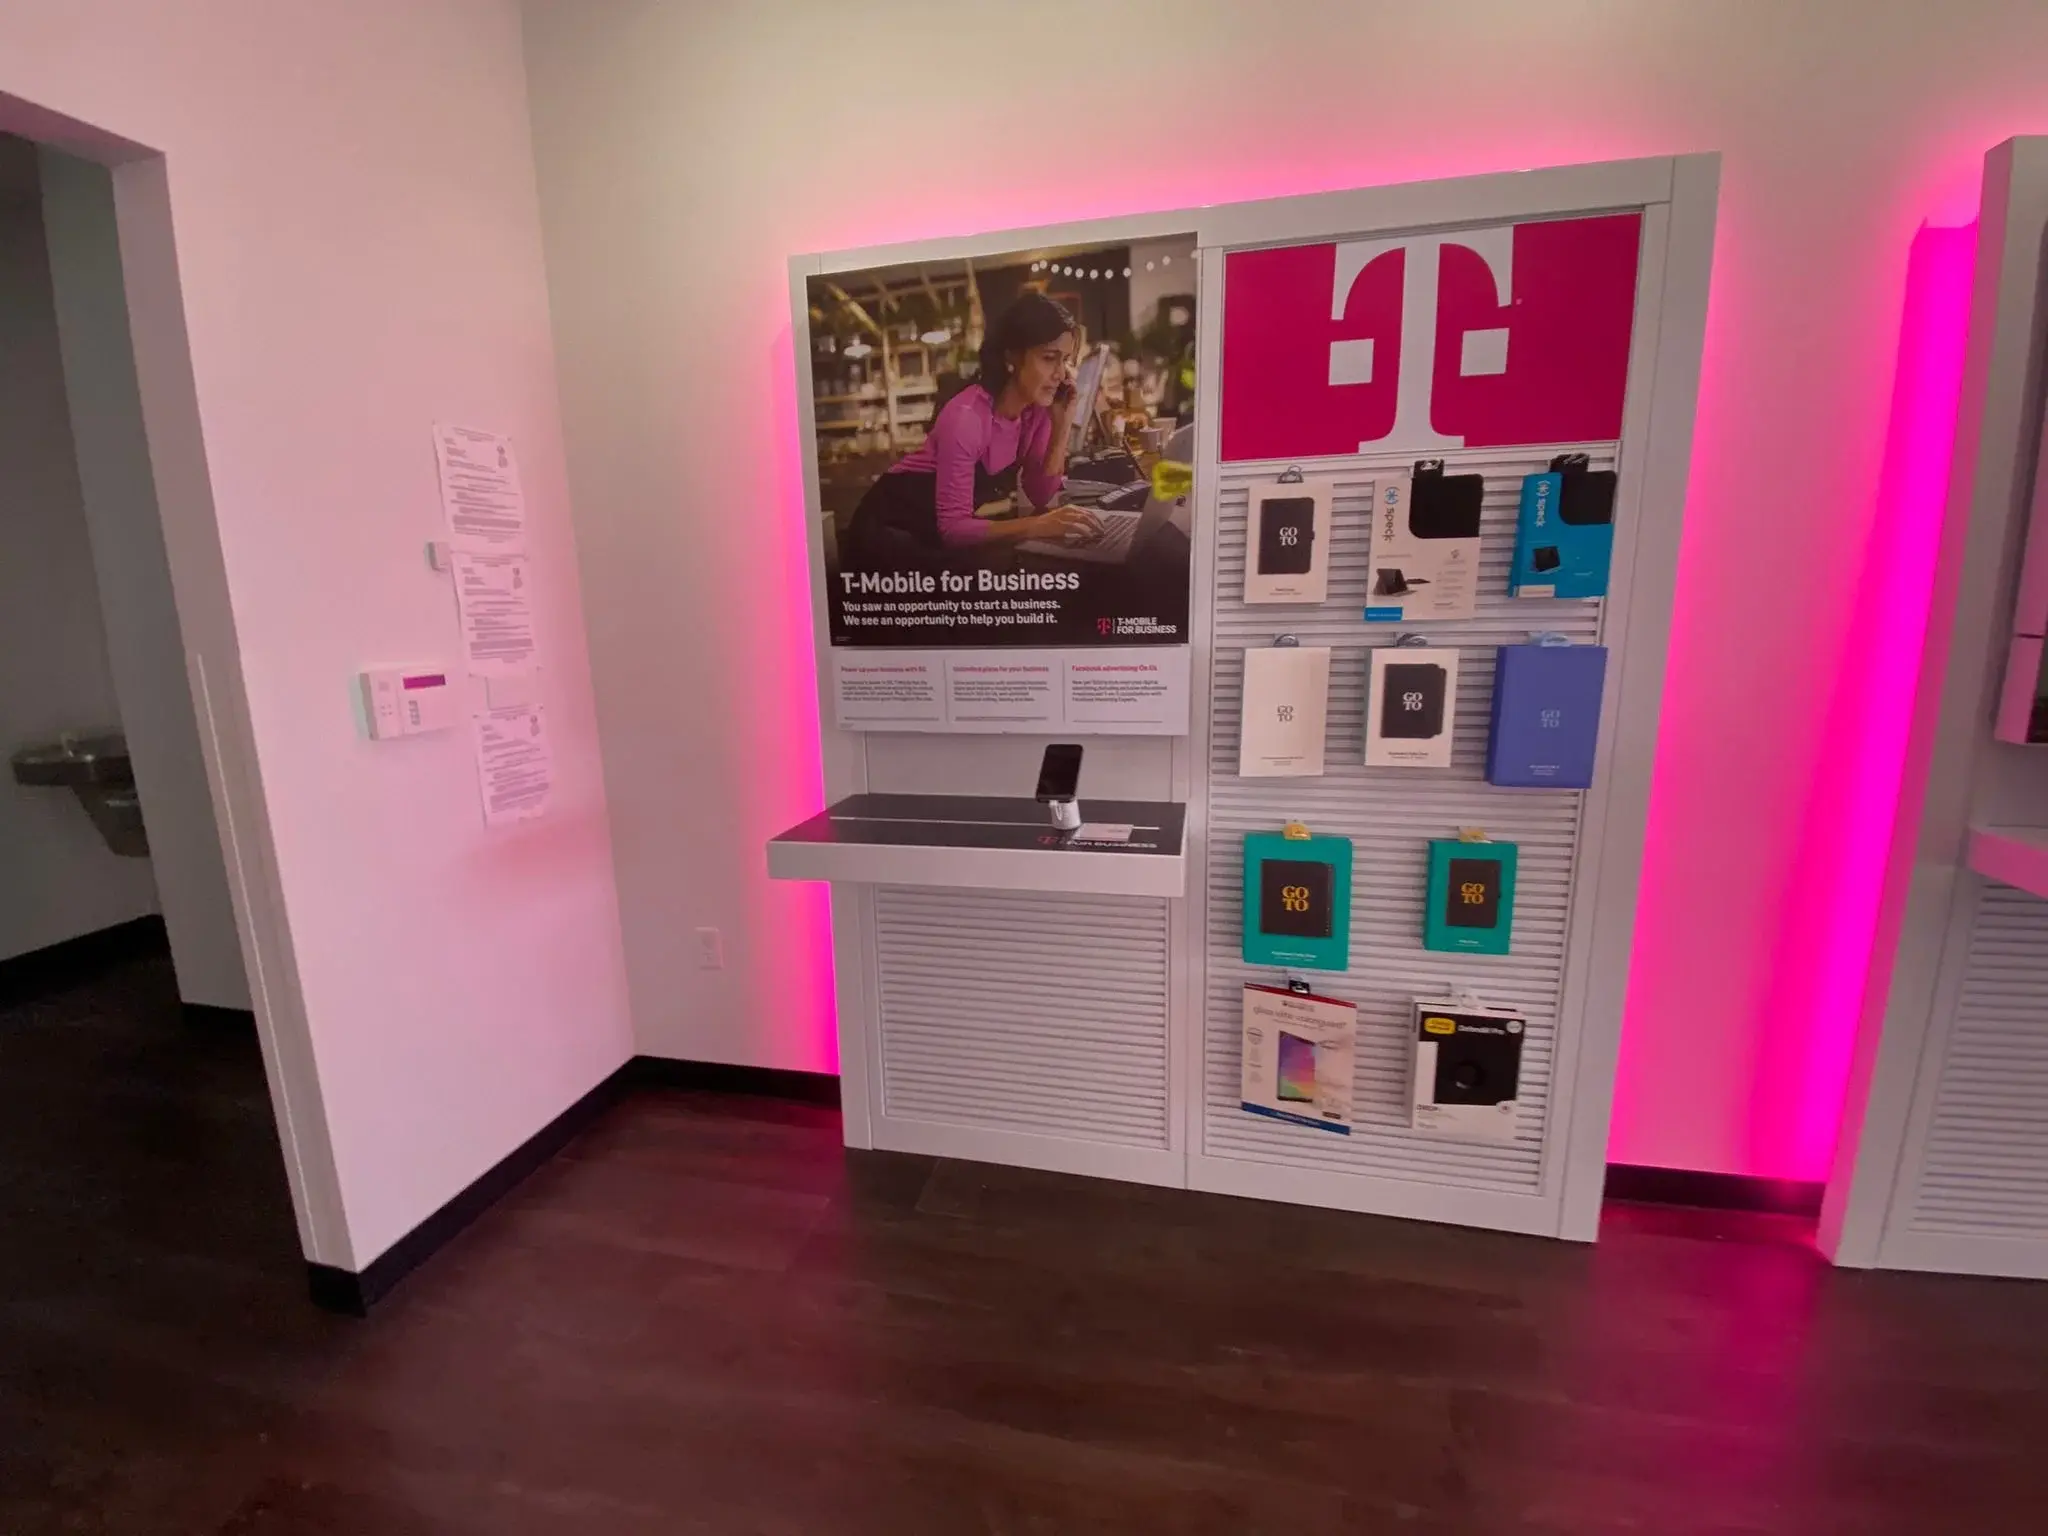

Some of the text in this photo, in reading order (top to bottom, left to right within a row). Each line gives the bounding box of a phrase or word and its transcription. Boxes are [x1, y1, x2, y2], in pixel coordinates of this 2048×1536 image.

[1534, 498, 1546, 528] speck
[1382, 507, 1396, 543] speck
[1279, 527, 1298, 537] GO
[1279, 537, 1298, 546] TO
[840, 568, 1080, 594] T-Mobile for Business
[842, 598, 1061, 613] You saw an opportunity to start a business.
[842, 612, 1058, 627] We see an opportunity to help you build it.
[1117, 617, 1157, 626] T-MOBILE
[1117, 624, 1177, 634] FOR BUSINESS
[1403, 692, 1423, 701] GO
[1277, 704, 1294, 713] GO
[1403, 701, 1423, 711] TO
[1277, 713, 1294, 722] TO
[1541, 709, 1560, 718] GO
[1541, 718, 1560, 728] TO
[1282, 886, 1310, 898] GO
[1461, 882, 1485, 893] GO
[1461, 893, 1485, 905] TO
[1282, 898, 1309, 912] TO
